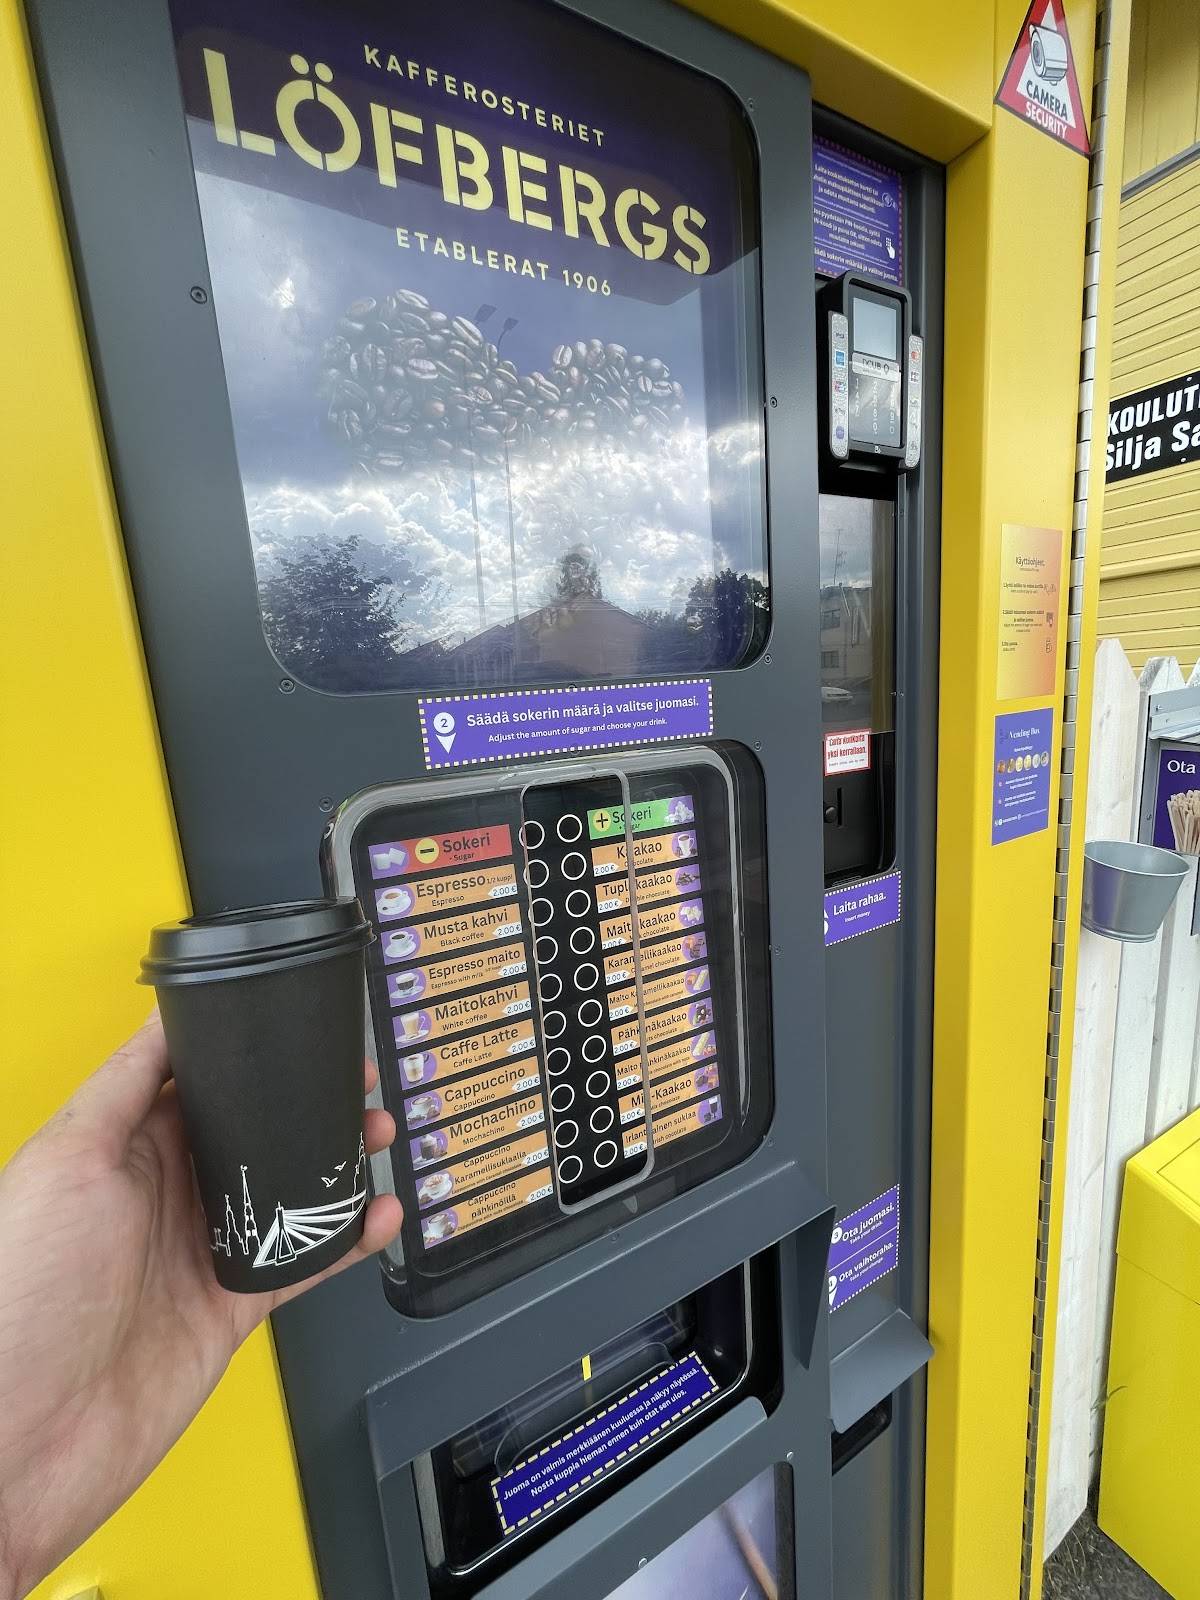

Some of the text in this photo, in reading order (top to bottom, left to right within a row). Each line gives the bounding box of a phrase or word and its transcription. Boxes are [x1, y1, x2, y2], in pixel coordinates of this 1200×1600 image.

[364, 44, 606, 148] KAFFEROSTERIET
[1026, 80, 1069, 121] CAMERA
[1025, 102, 1068, 139] SECURITY
[203, 48, 711, 275] LÖFBERGS
[396, 228, 612, 297] ETABLERAT 1906
[1108, 384, 1200, 435] KOULUT
[1106, 434, 1161, 471] Silja
[466, 695, 699, 727] Säädä sokerin määrä ja valitse juomasi.
[439, 718, 448, 728] 2
[488, 717, 668, 743] Adjust the amount of sugar and choose your drink.
[1167, 759, 1196, 774] Ota
[442, 832, 491, 853] Sokeri
[617, 842, 662, 859] Kakao
[454, 852, 475, 863] Sugar
[594, 865, 609, 875] 2.00
[416, 875, 486, 898] Espresso
[493, 885, 517, 897] 2.00 €
[603, 875, 672, 896] Tuplkaakao
[431, 894, 465, 907] Espresso
[599, 902, 612, 911] 2.00
[834, 892, 886, 915] Laita rahaa.
[424, 909, 508, 940] Musta kahvi
[497, 923, 521, 936] 2.00 €
[606, 912, 676, 938] Maitkaakao
[440, 931, 484, 947] Black coffee
[428, 949, 520, 980] Espresso maito
[503, 965, 520, 976] 2.00
[521, 964, 527, 972] €
[431, 979, 457, 989] Espresso
[458, 975, 471, 983] with
[607, 973, 621, 983] 2.00
[435, 985, 519, 1021] Maitokahvi
[507, 1001, 531, 1014] 2.00 €
[443, 1013, 488, 1031] White coffee
[618, 1013, 687, 1040] Pähknäkaakao
[440, 1028, 519, 1060] Caffe Latte
[511, 1042, 528, 1053] 2.00
[614, 1043, 629, 1053] 2.00
[453, 1051, 493, 1068] Caffe Latte
[444, 1067, 526, 1102] Cappuccino
[516, 1079, 533, 1090] 2.00
[617, 1078, 631, 1088] 2.00
[631, 1079, 692, 1107] Mi-Kaakao
[453, 1093, 496, 1112] Cappuccino
[450, 1098, 536, 1138] Mochachino
[521, 1113, 544, 1127] 2.00 €
[621, 1111, 636, 1122] 2.00
[463, 1126, 505, 1145] Mochachino
[454, 1151, 527, 1184] Karamellisuklaalla
[463, 1145, 511, 1168] Cappuccino
[526, 1153, 542, 1164] 2.00
[467, 1182, 516, 1207] Cappuccino
[530, 1186, 553, 1201] 2.00 €
[471, 1194, 516, 1220] pähkinöillä
[842, 1228, 858, 1241] Ota
[859, 1202, 894, 1233] juomasi.
[839, 1243, 894, 1282] Ota vaihtoraha.
[503, 1367, 699, 1500] Juoma on valmis merkkiäänen kuuluessa ja näkyy näytössä.
[530, 1390, 687, 1497] Nosta kuppia hieman ennen kuin otat sen ulos.
